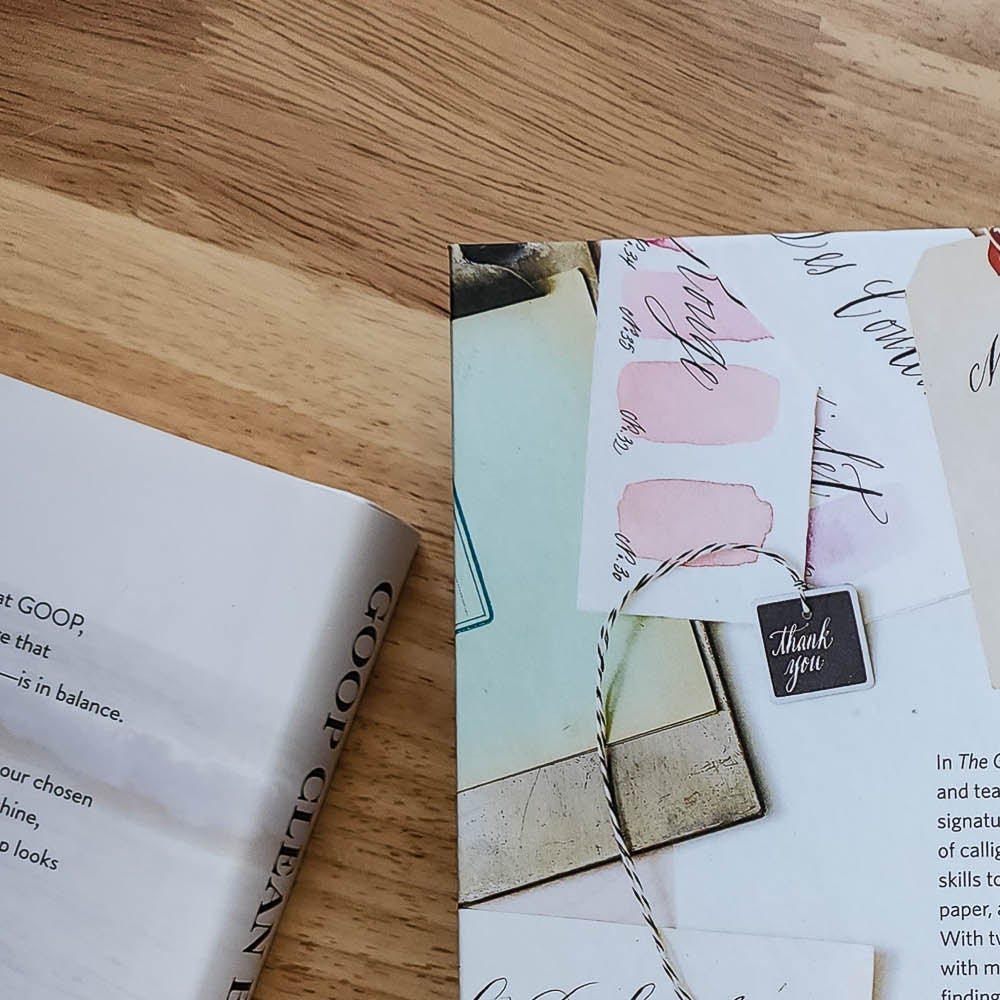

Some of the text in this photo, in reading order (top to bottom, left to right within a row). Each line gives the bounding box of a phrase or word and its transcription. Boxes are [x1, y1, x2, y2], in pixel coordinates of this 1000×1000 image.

[18, 596, 85, 637] GOOP,
[15, 634, 52, 659] that
[769, 616, 834, 657] thank
[322, 581, 393, 750] GOOP
[784, 655, 825, 693] you
[35, 676, 51, 697] in
[56, 683, 124, 723] balance.
[936, 753, 952, 771] In
[958, 752, 989, 770] The
[33, 775, 93, 808] chosen
[936, 781, 969, 800] and
[13, 840, 59, 870] looks
[241, 767, 327, 956] CLEAN
[937, 841, 956, 859] of
[938, 870, 982, 888] skills
[939, 904, 993, 921] paper,
[939, 929, 984, 947] With
[940, 958, 978, 977] with
